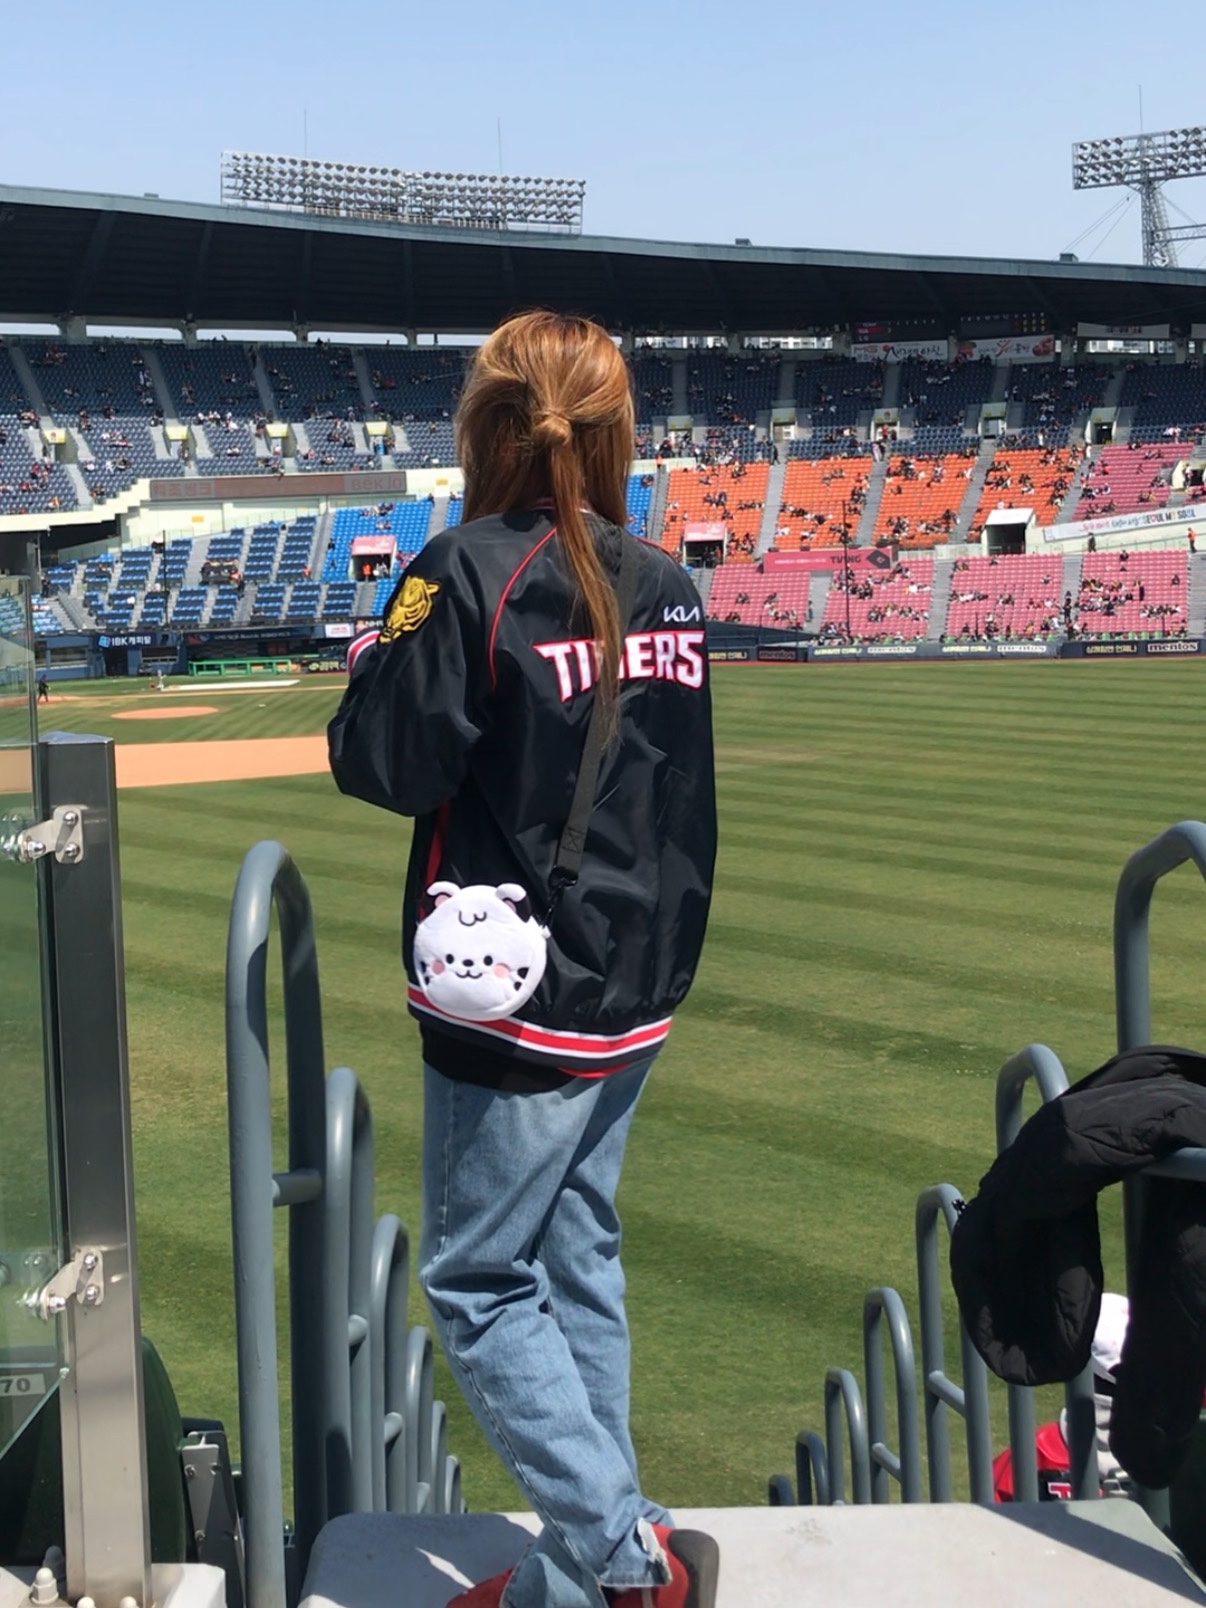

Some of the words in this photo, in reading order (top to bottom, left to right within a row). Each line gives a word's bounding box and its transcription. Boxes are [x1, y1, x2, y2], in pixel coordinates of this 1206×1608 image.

[830, 554, 862, 564] TVNG
[663, 605, 700, 622] KIA
[1147, 640, 1198, 652] mentos
[532, 629, 705, 702] TIERS
[0, 1377, 31, 1393] 70
